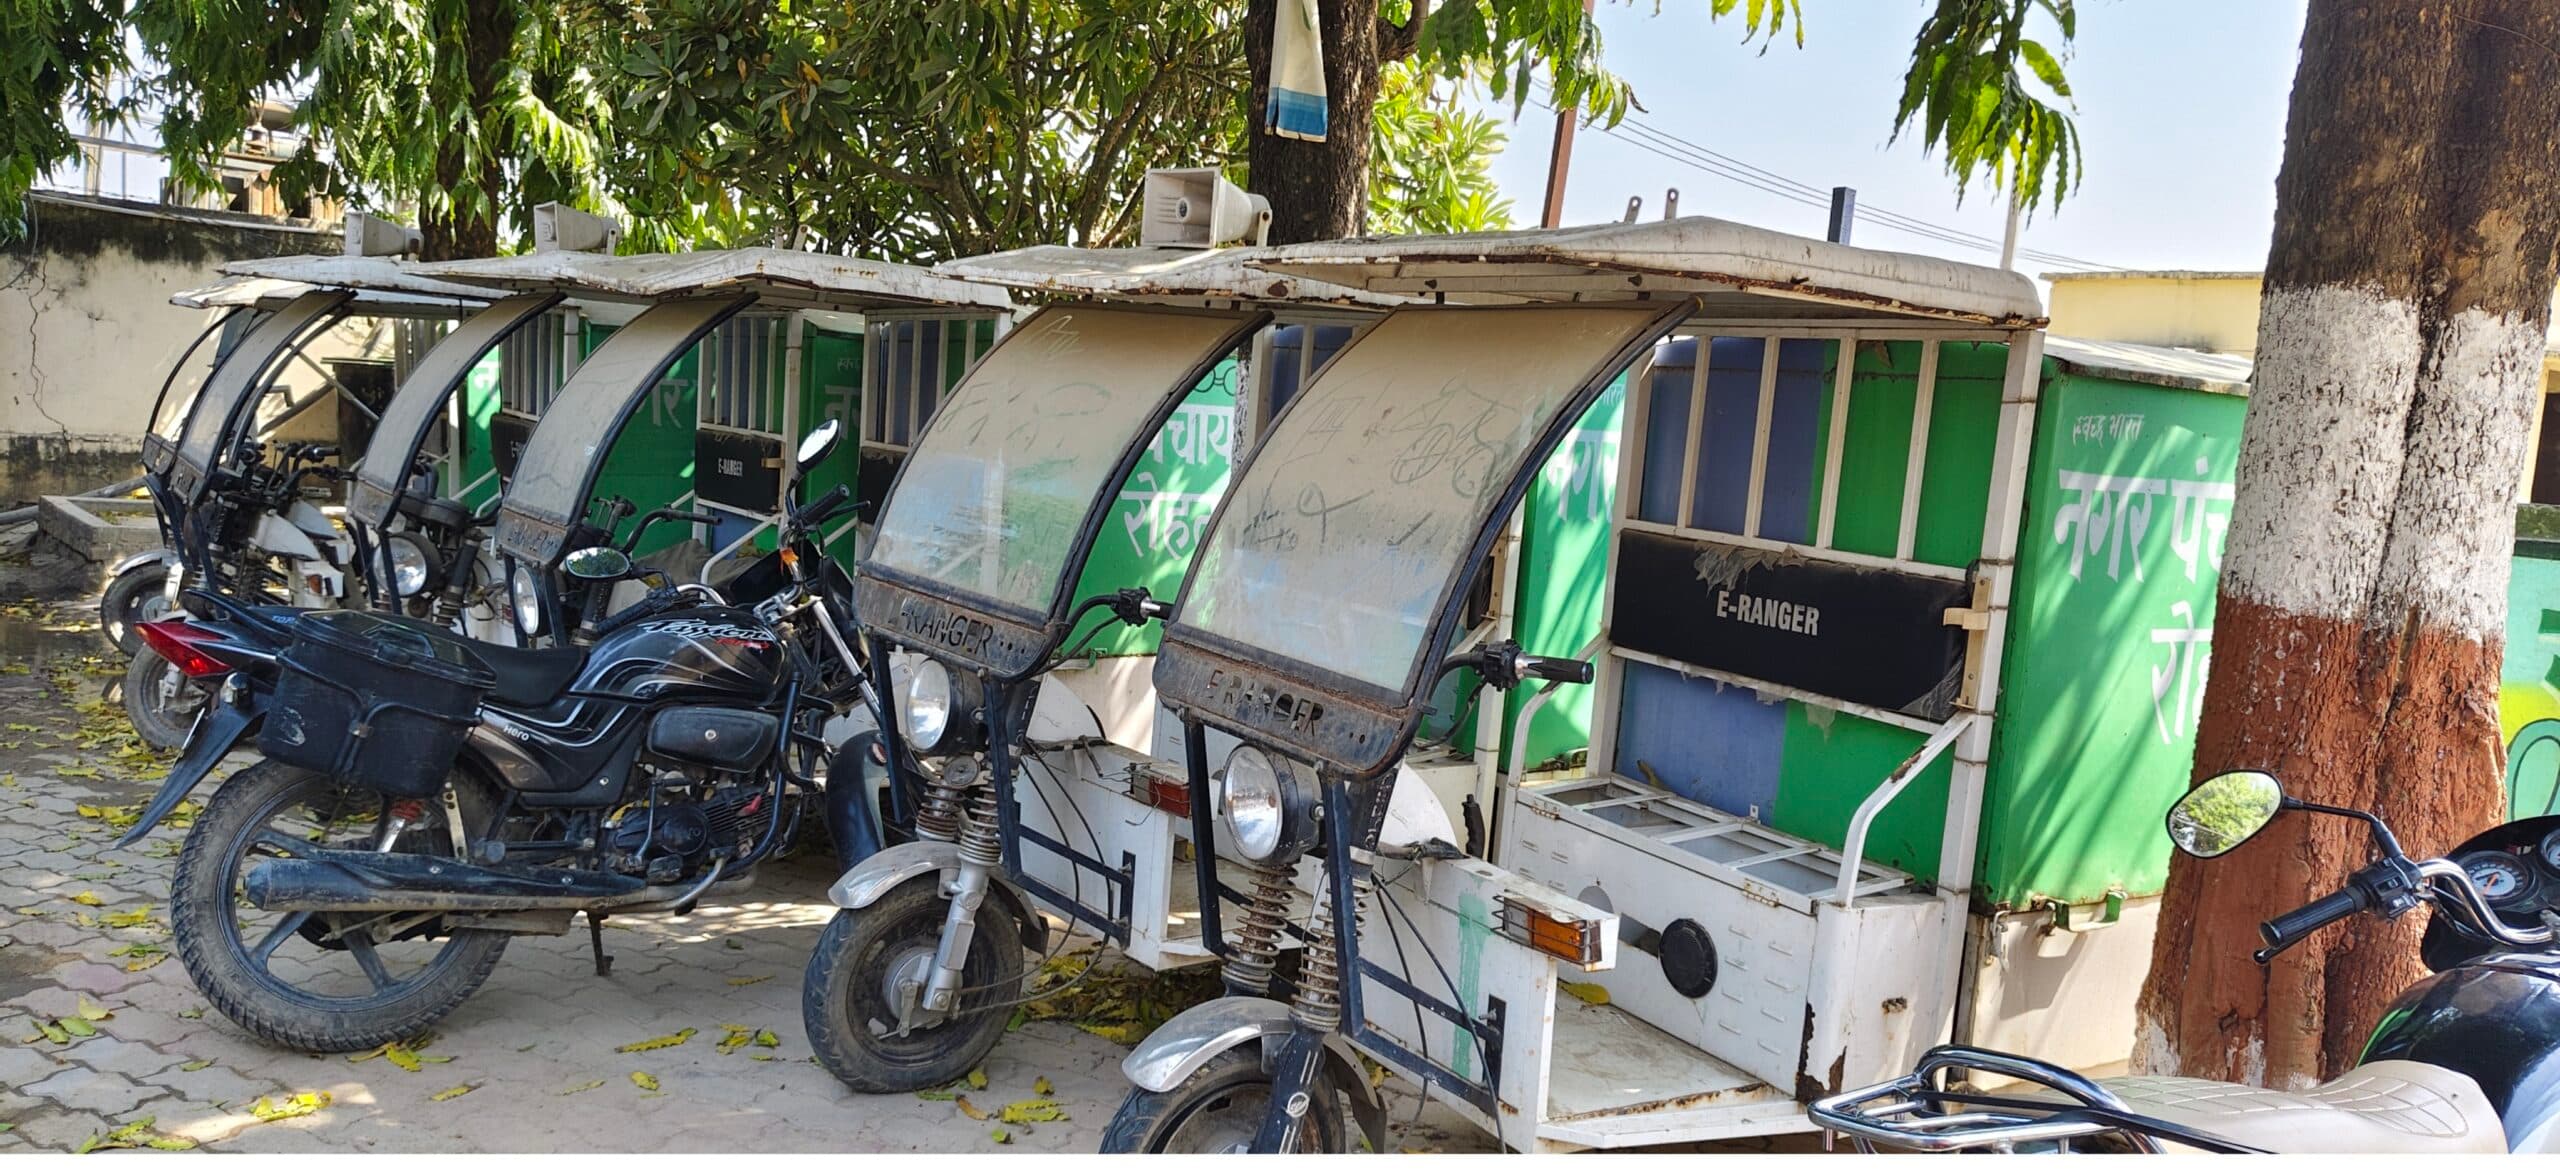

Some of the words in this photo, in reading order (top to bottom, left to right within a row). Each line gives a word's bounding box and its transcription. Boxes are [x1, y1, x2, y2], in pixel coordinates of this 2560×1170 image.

[2054, 468, 2166, 583] नगर
[1717, 590, 1820, 636] E-RANGER
[503, 724, 530, 741] Hero
